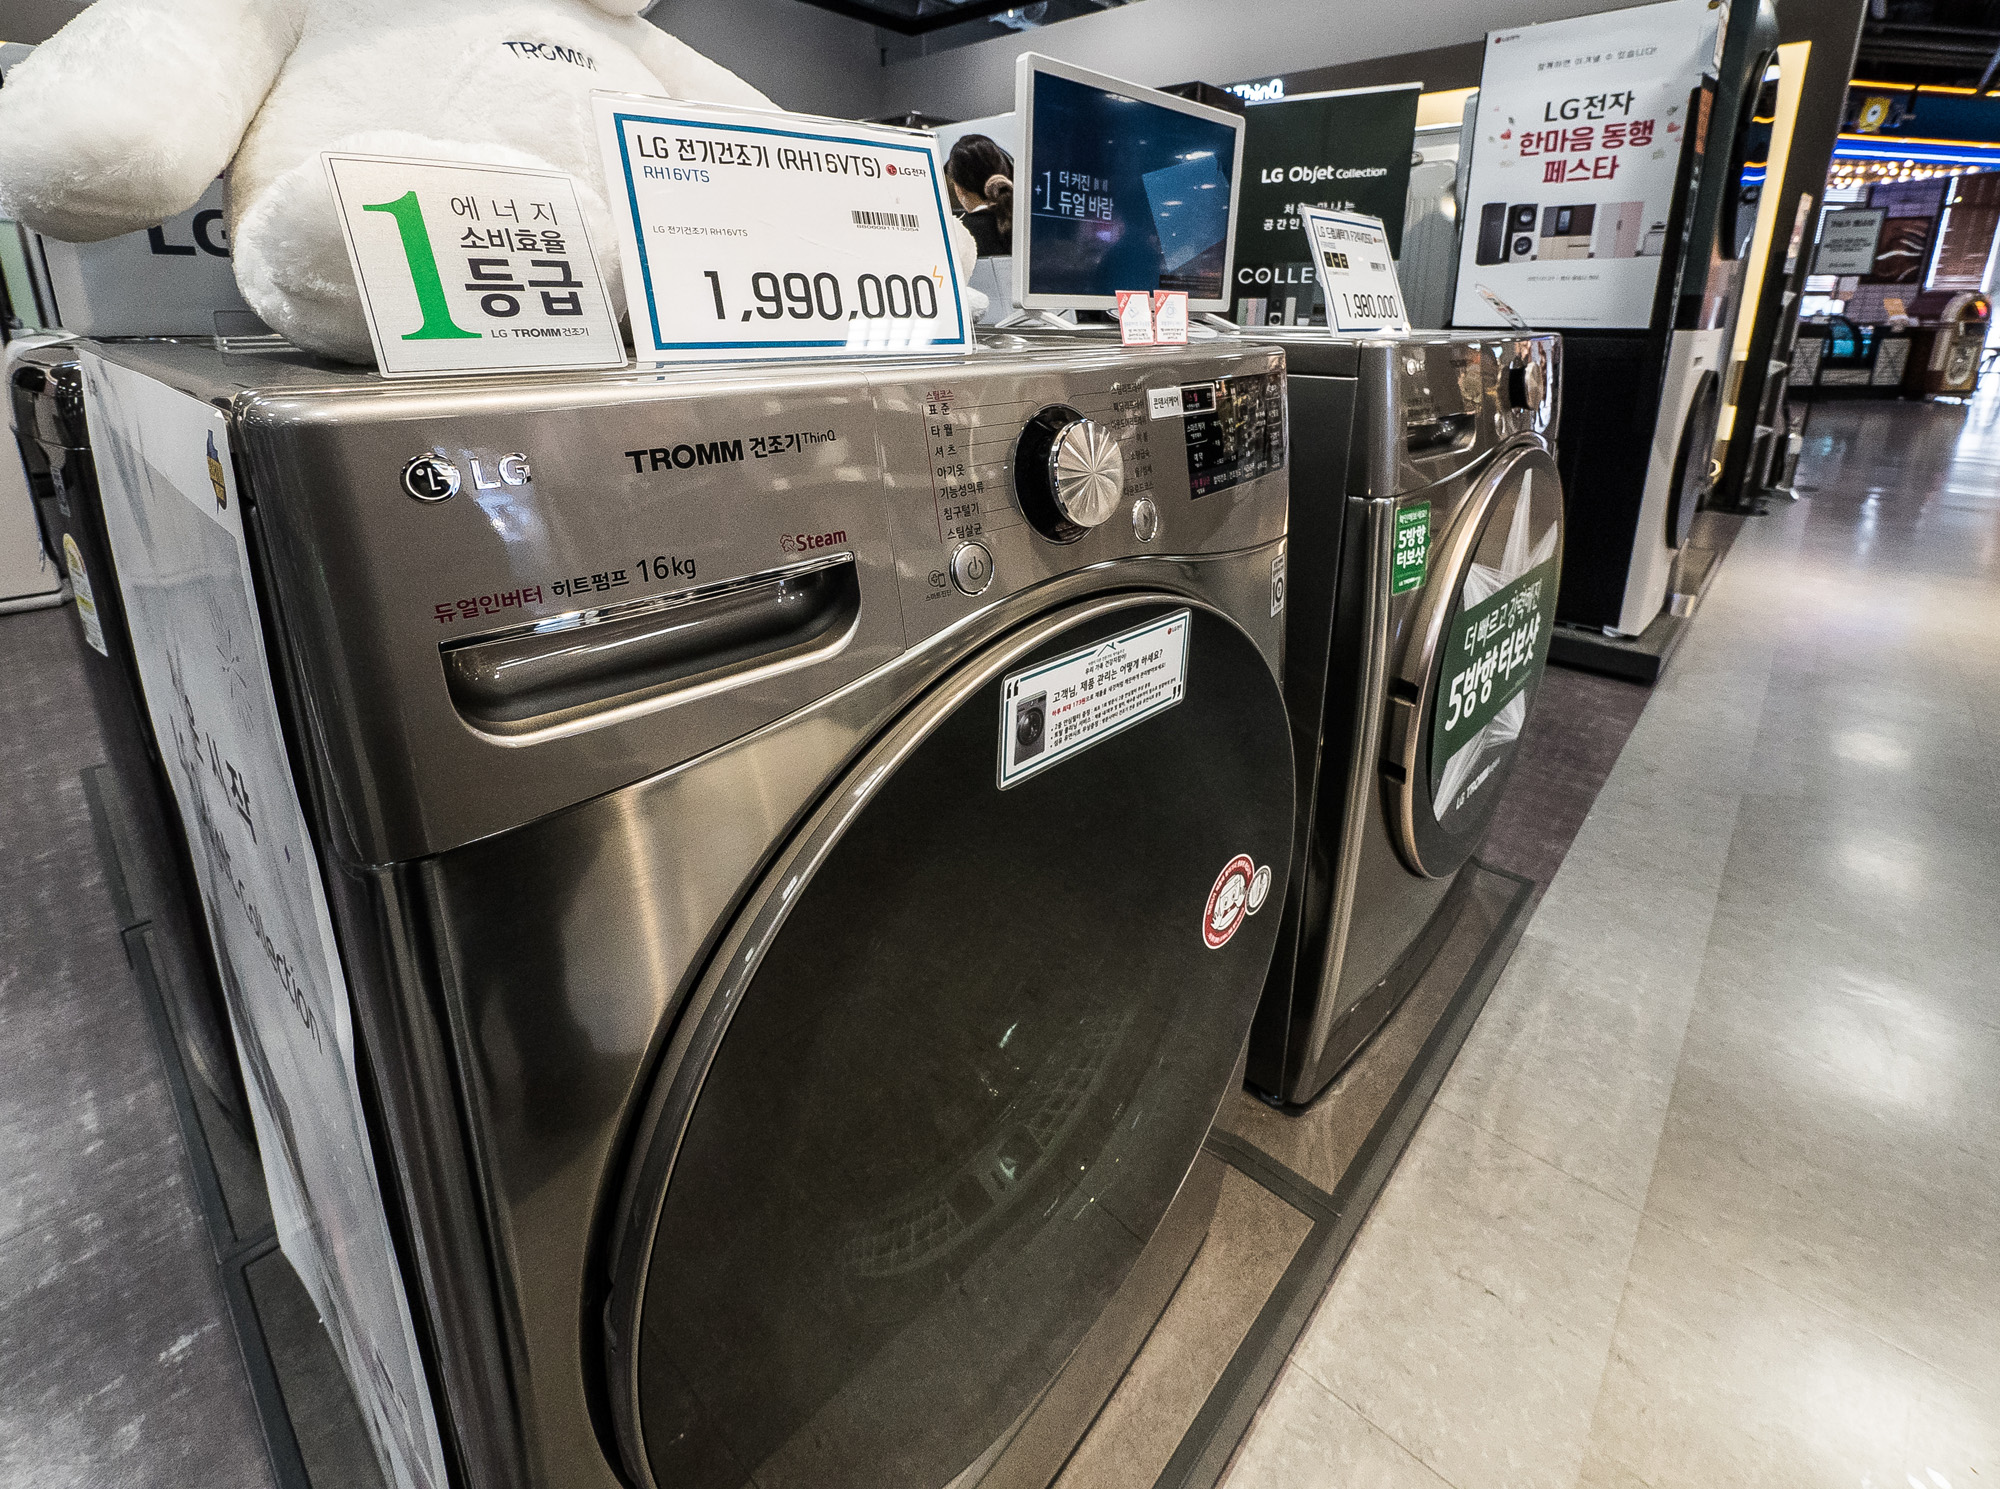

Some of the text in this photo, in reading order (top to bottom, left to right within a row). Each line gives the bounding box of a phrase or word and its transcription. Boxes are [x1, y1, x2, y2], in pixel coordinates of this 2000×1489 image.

[502, 41, 597, 72] TROMM
[1233, 78, 1285, 101] ThinQ
[1544, 90, 1636, 122] LG전자
[1520, 118, 1655, 157] 한마음 동행
[637, 134, 882, 179] LG 전기건조기 (RH16VTS)
[1543, 155, 1620, 183] 페스타
[643, 165, 710, 183] RH16VTS
[899, 166, 927, 178] LG전자
[1059, 171, 1069, 188] 더
[1071, 173, 1091, 192] 커진
[1261, 165, 1387, 184] LG Objet Collection
[450, 196, 559, 226] 에너지
[1058, 191, 1114, 220] 듀얼 바람
[652, 225, 748, 237] LG 전기건조기 RH16VTS
[1263, 218, 1306, 231] 공간인
[460, 226, 567, 255] 소비효율
[362, 190, 483, 340] 1
[1238, 267, 1314, 284] COLLE
[465, 258, 584, 317] 등급
[703, 270, 938, 322] 1,990,000
[1342, 293, 1399, 319] 1,980,000
[491, 329, 508, 339] LG
[926, 389, 954, 400] 스팀코스
[1153, 395, 1180, 410] 콘덴서케어
[625, 439, 745, 474] TROMM
[468, 452, 532, 491] LG
[937, 464, 965, 479] 아기옷
[939, 481, 985, 500] 기능성의류
[943, 503, 980, 521] 침구털기
[795, 528, 848, 552] Steam
[947, 522, 983, 540] 스팀살균
[1398, 524, 1426, 549] 5방향
[1396, 545, 1425, 569] 터보샷
[432, 555, 697, 624] 듀얼인버터 히트펌프 16kg
[1464, 621, 1478, 656] 더
[1052, 683, 1077, 705] 고객님,
[1080, 676, 1094, 693] 제품
[1096, 666, 1117, 686] 관리는
[1119, 658, 1138, 676] 어떻게
[1140, 648, 1162, 667] 하세요?
[1444, 612, 1541, 731] 5방향 터보샷
